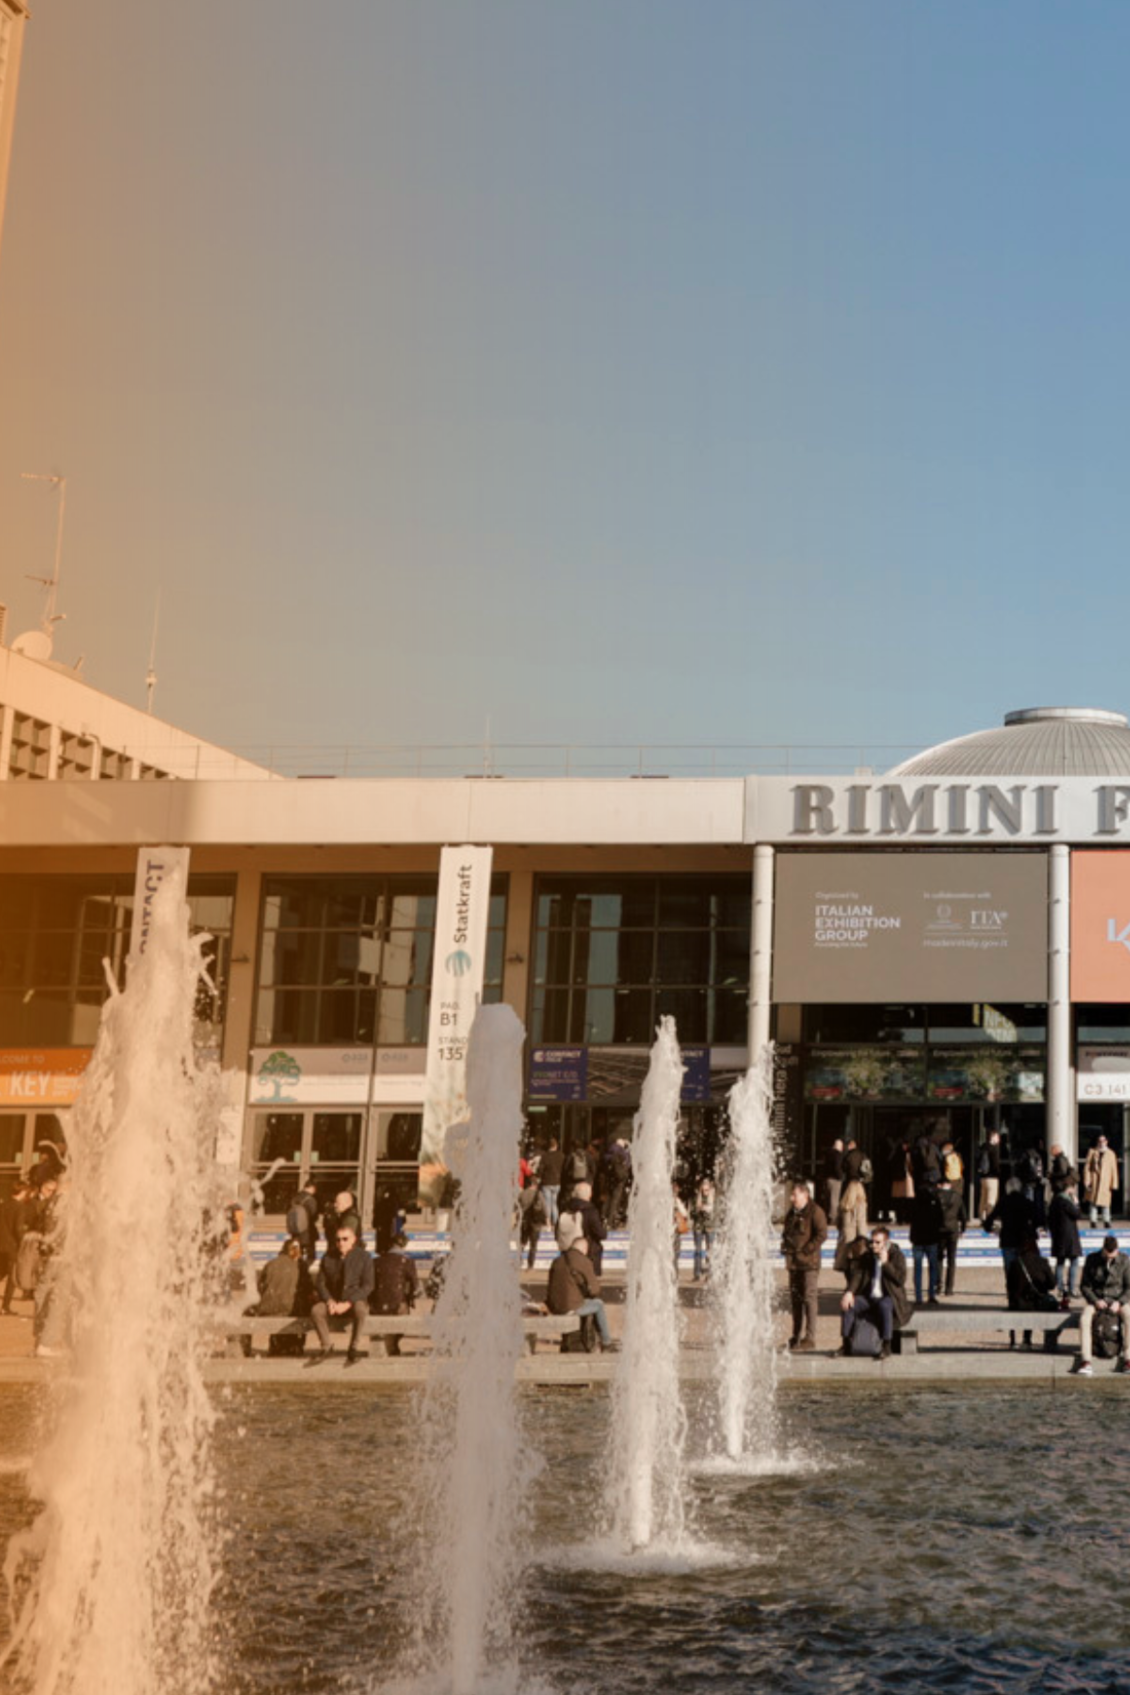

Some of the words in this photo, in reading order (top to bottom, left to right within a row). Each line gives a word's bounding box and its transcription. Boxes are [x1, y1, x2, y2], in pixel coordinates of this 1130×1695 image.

[788, 783, 1060, 837] RIMINI
[453, 864, 473, 944] Statkraft
[815, 904, 873, 916] ITALIAN
[815, 916, 900, 929] EXHIBITION
[815, 929, 868, 941] GROUP
[440, 1013, 458, 1026] B1
[437, 1047, 463, 1061] 135
[10, 1070, 50, 1097] KEY
